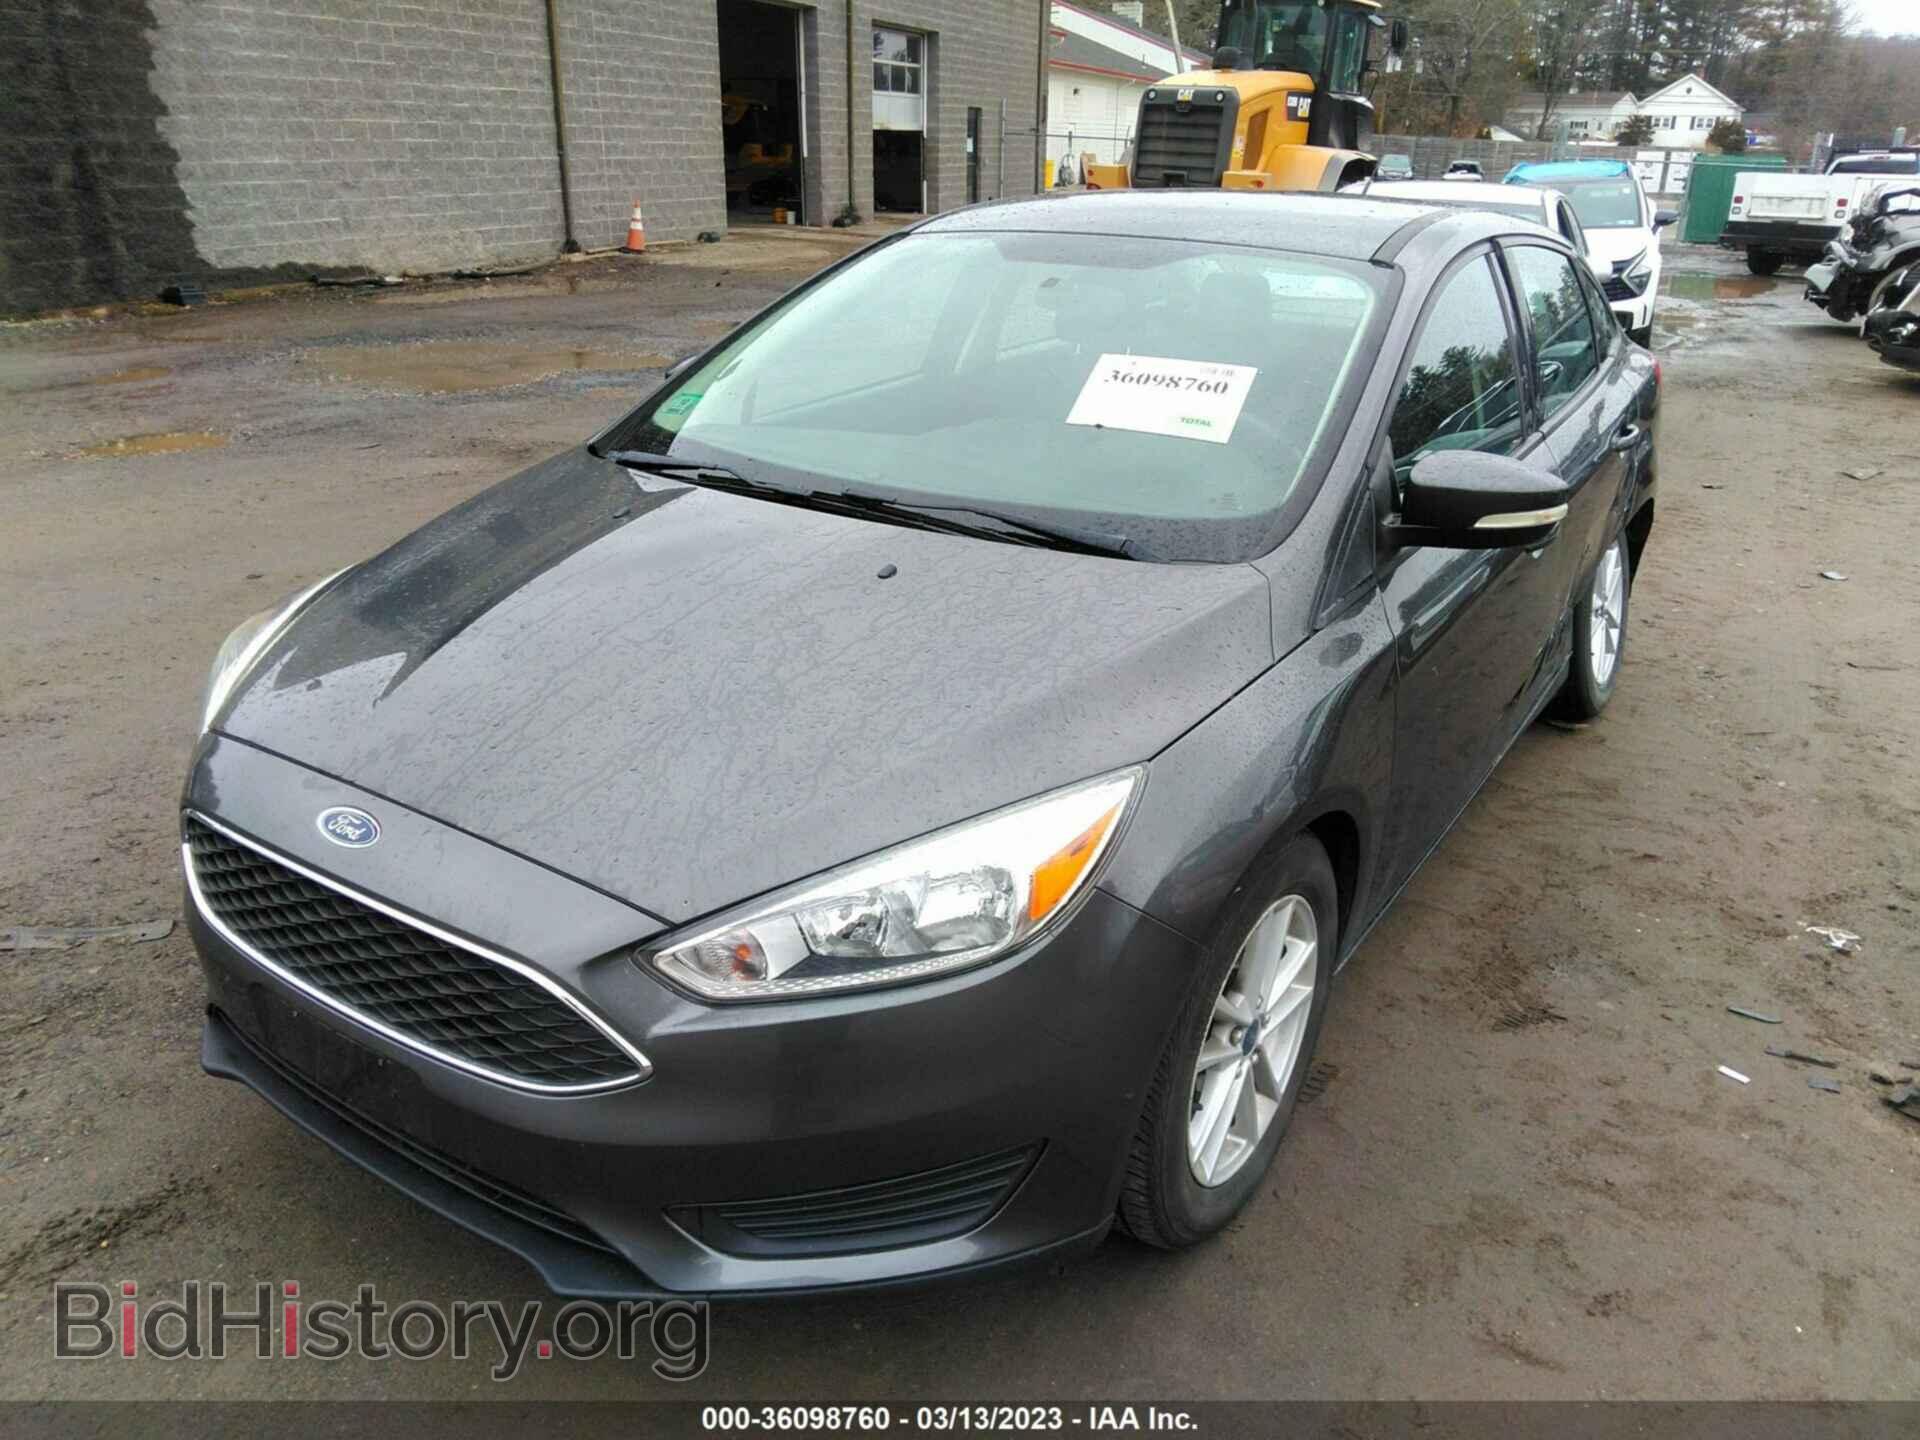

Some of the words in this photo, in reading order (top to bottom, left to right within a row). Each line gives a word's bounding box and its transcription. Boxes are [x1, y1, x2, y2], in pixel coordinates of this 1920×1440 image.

[1177, 89, 1194, 101] CAT
[1297, 97, 1312, 118] CAT
[1104, 369, 1229, 394] 36098760
[1180, 416, 1212, 428] TOTAL
[327, 814, 367, 841] Ford
